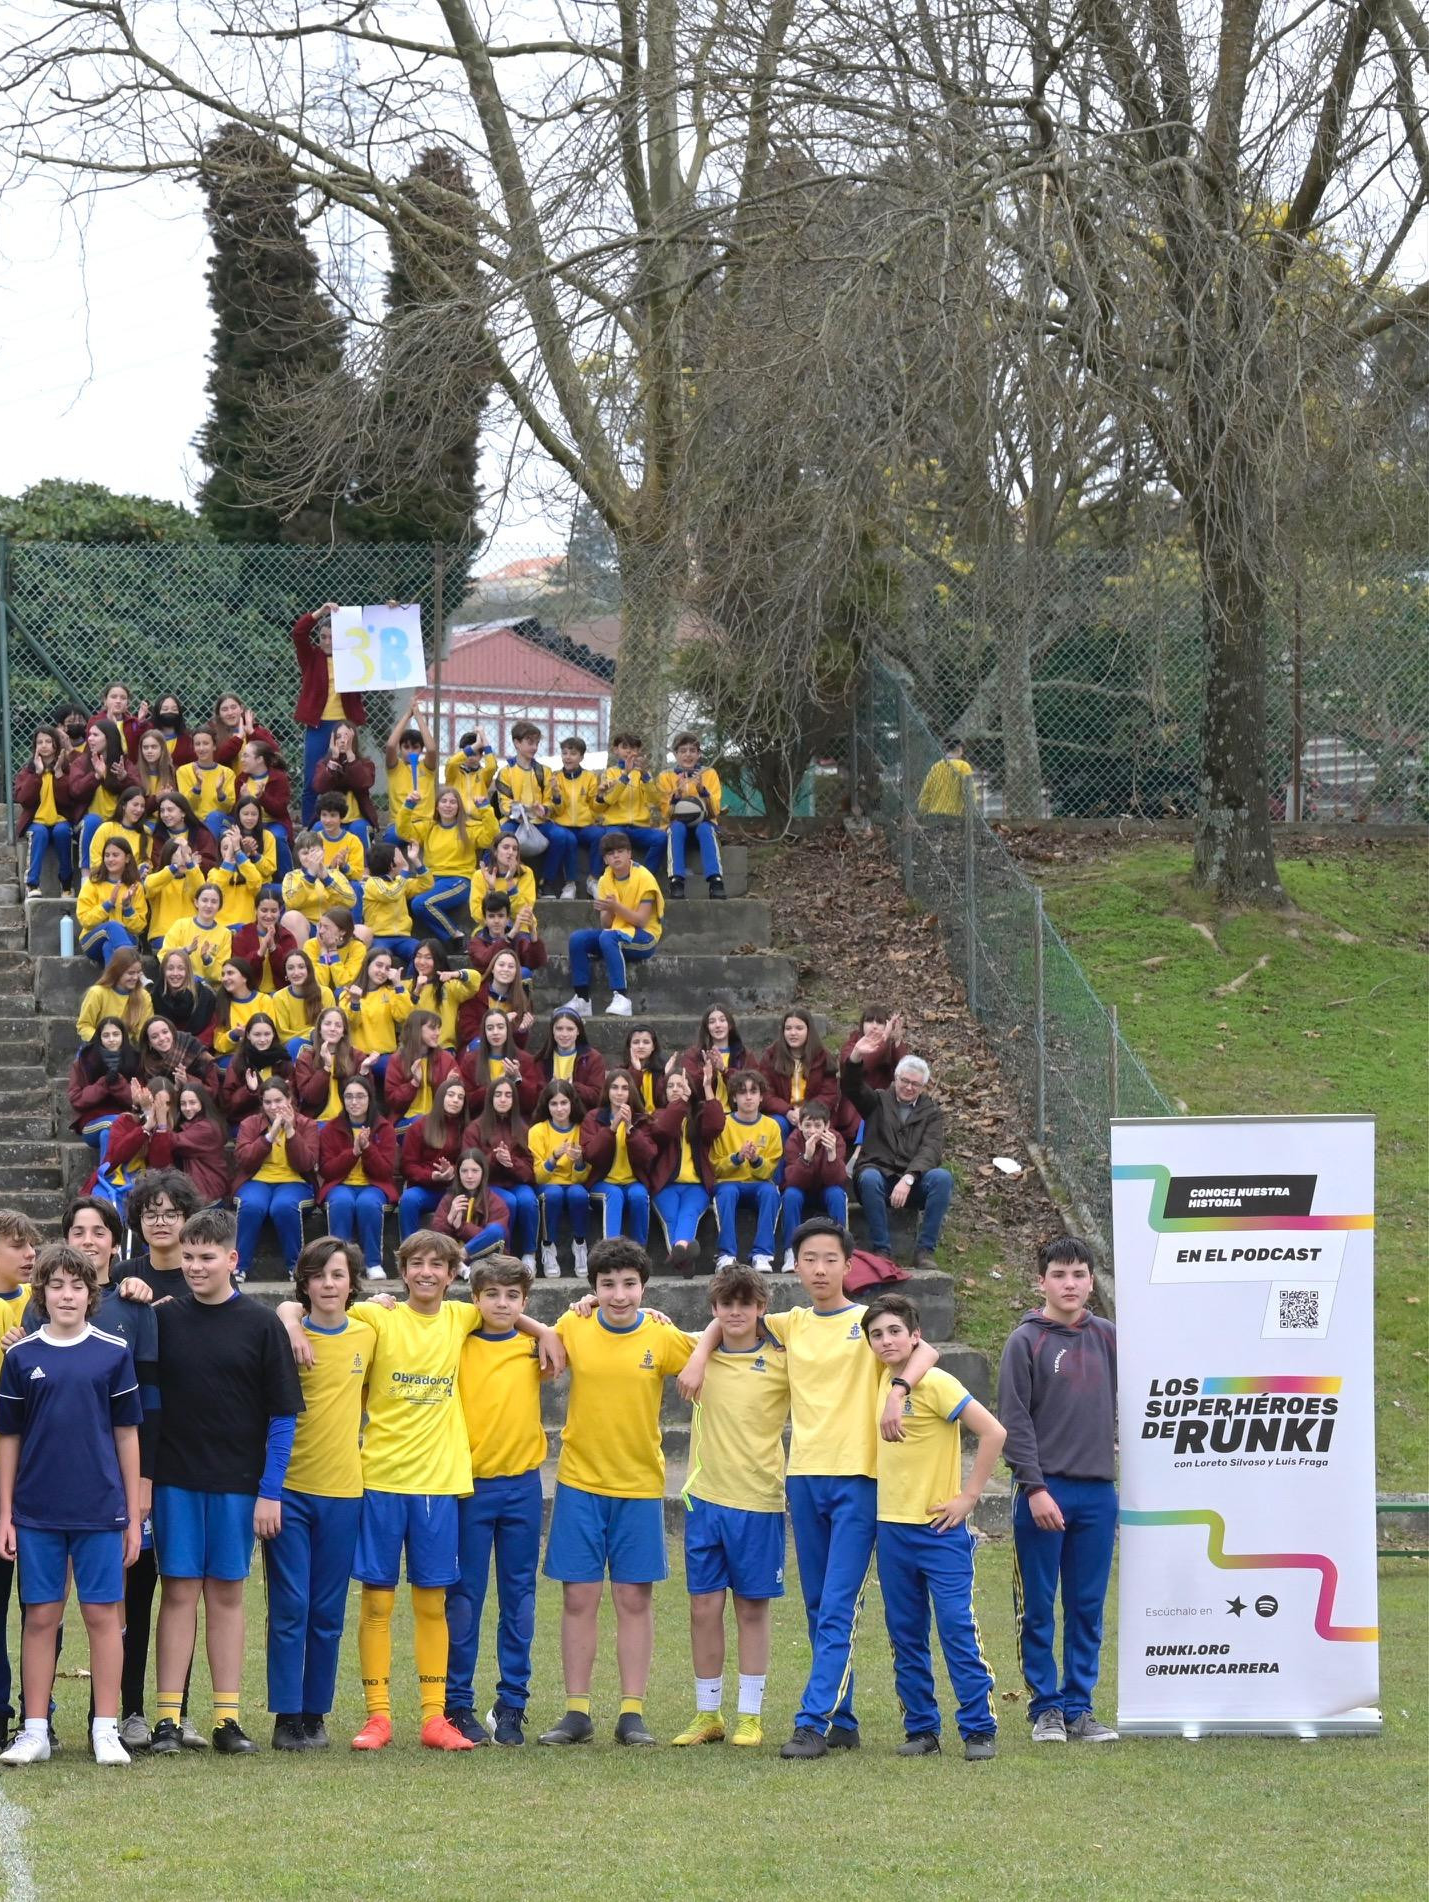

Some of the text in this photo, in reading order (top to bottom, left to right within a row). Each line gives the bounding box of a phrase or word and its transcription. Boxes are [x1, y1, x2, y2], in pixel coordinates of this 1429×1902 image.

[1190, 1187, 1290, 1198] CONOCE NUESTRA
[1188, 1198, 1242, 1208] HISTORIA
[1176, 1248, 1322, 1263] EN EL PODCAST
[392, 1372, 450, 1385] Obradoiro
[1149, 1378, 1199, 1397] LOS
[1144, 1392, 1339, 1418] SUPERHÉROES
[1141, 1418, 1335, 1454] DE RUNKI
[1174, 1457, 1329, 1469] con Loreto Silvoso y Luis Fraga
[1145, 1607, 1212, 1617] Escúchalo en
[1145, 1644, 1230, 1656] RUNKI.ORG
[1145, 1663, 1280, 1676] @RUNKICARRERA
